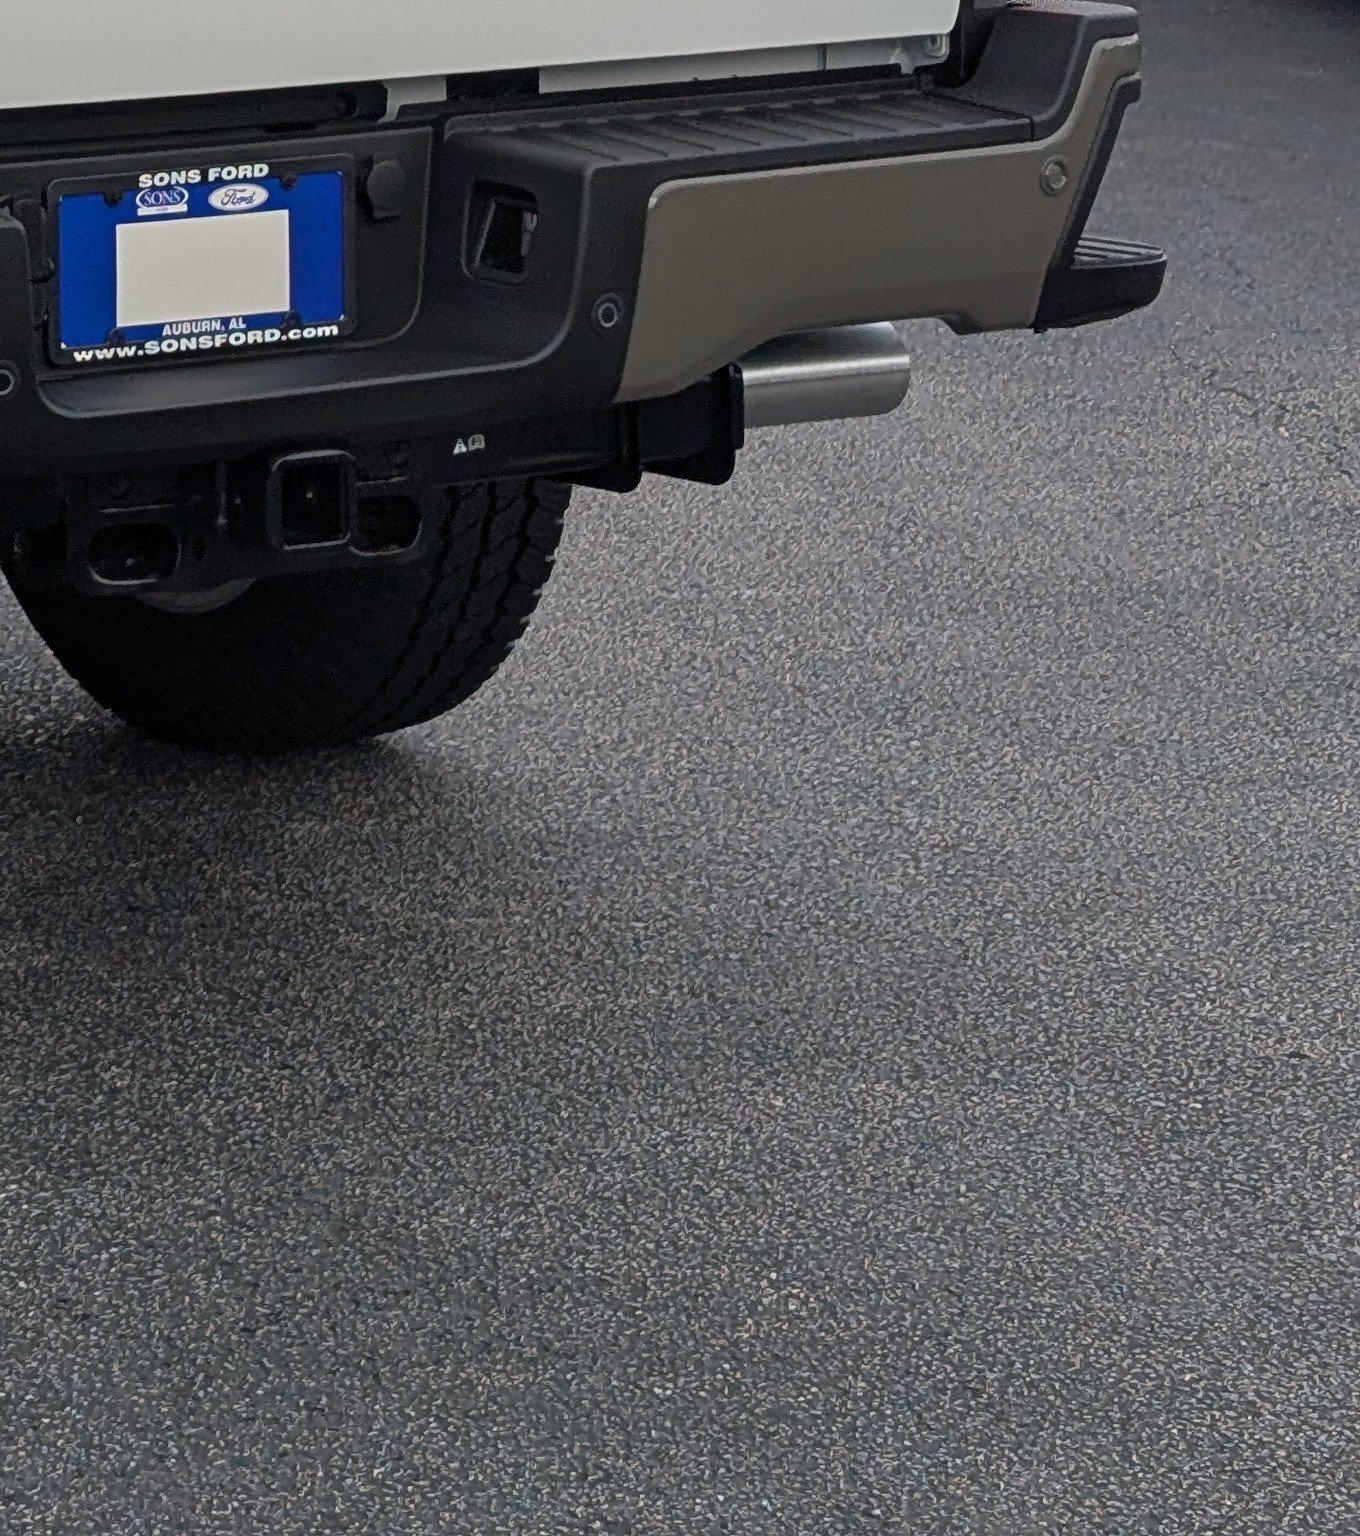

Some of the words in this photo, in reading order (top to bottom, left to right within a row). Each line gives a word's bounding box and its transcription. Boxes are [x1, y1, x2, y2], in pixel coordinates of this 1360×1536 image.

[138, 169, 201, 188] SONS
[208, 163, 269, 182] FORD
[144, 189, 181, 206] SONS
[220, 188, 256, 206] Ford
[229, 316, 247, 330] AL
[72, 323, 339, 363] www.SONSFORD.com
